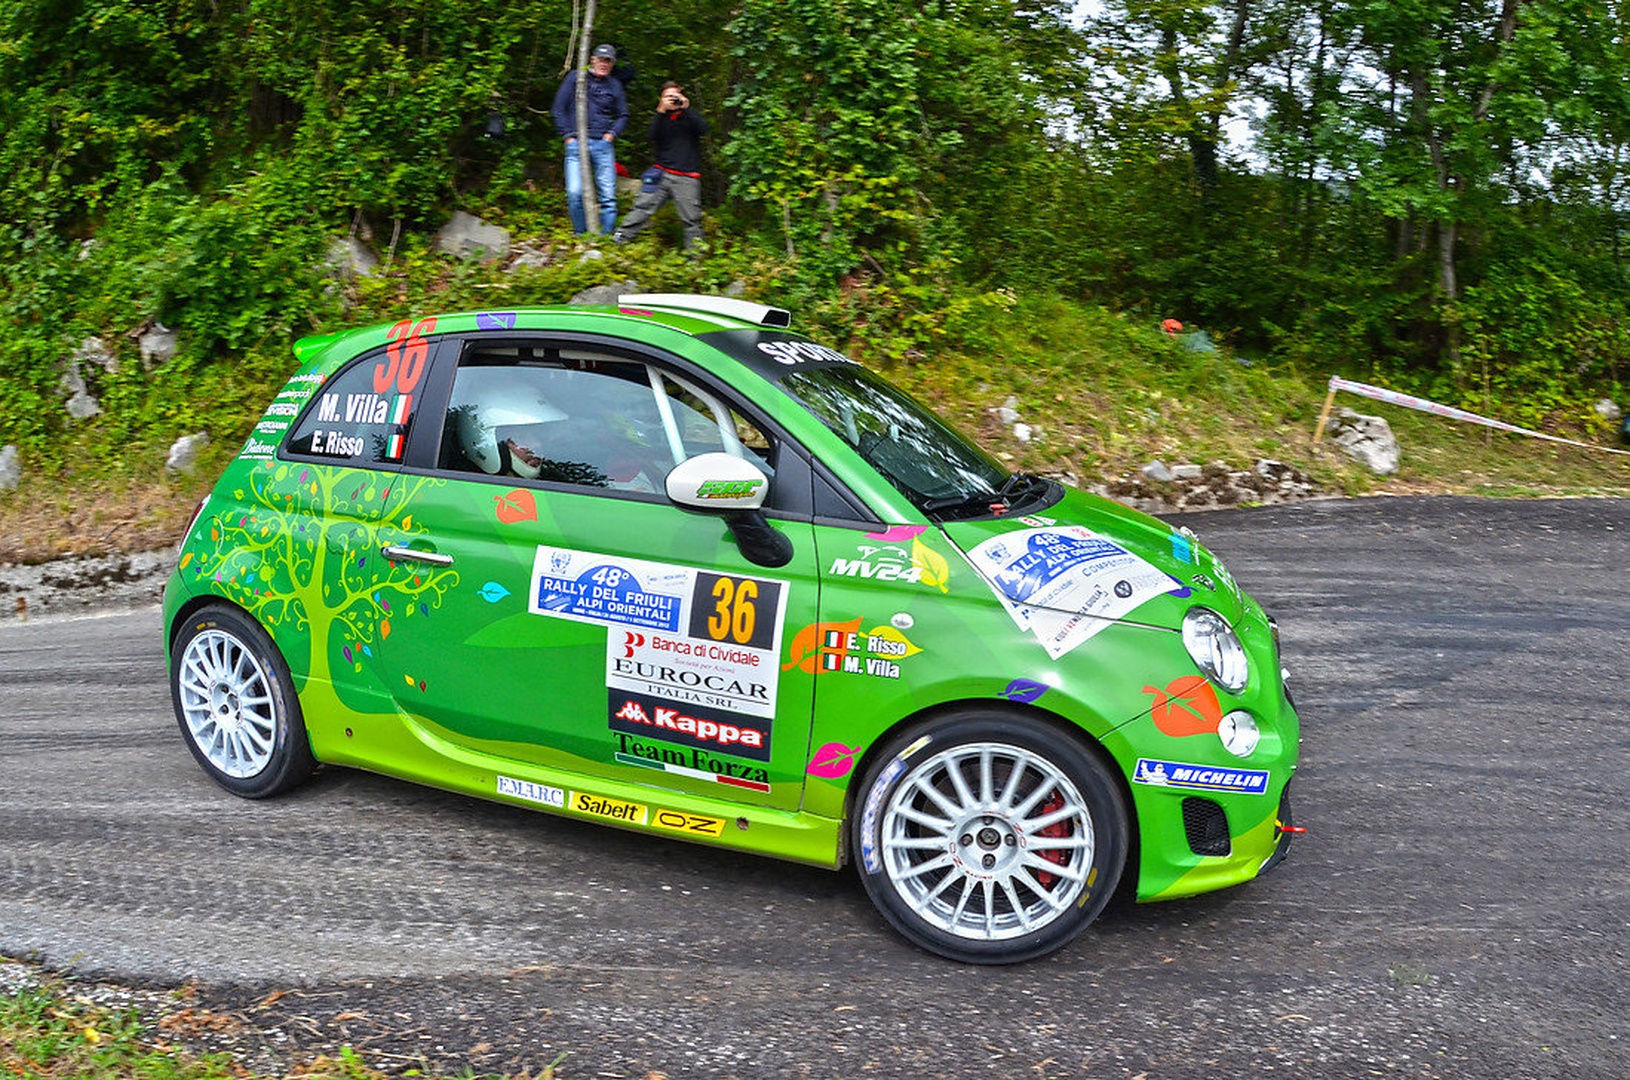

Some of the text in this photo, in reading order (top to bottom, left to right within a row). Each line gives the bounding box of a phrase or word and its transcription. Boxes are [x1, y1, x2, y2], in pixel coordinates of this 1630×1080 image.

[373, 317, 438, 394] 36
[757, 341, 863, 366] SPORT
[317, 393, 340, 422] M.
[345, 394, 388, 424] Villa
[311, 430, 364, 456] E. Risso
[591, 567, 630, 587] 48°
[829, 558, 923, 584] MV24
[543, 577, 673, 610] RALLY DEL FRIULI
[576, 597, 671, 621] ALPI ORIENTALI
[707, 576, 759, 644] 36
[652, 637, 760, 667] Banca di Cividale
[846, 632, 907, 656] E. Risso
[613, 657, 769, 700] EUROCAR
[844, 655, 900, 679] M. Villa
[647, 685, 701, 703] ITALIA
[655, 708, 763, 747] Kappa
[613, 732, 769, 784] Team Forza
[1171, 768, 1265, 787] MICHELIN
[578, 794, 639, 821] Sabelt
